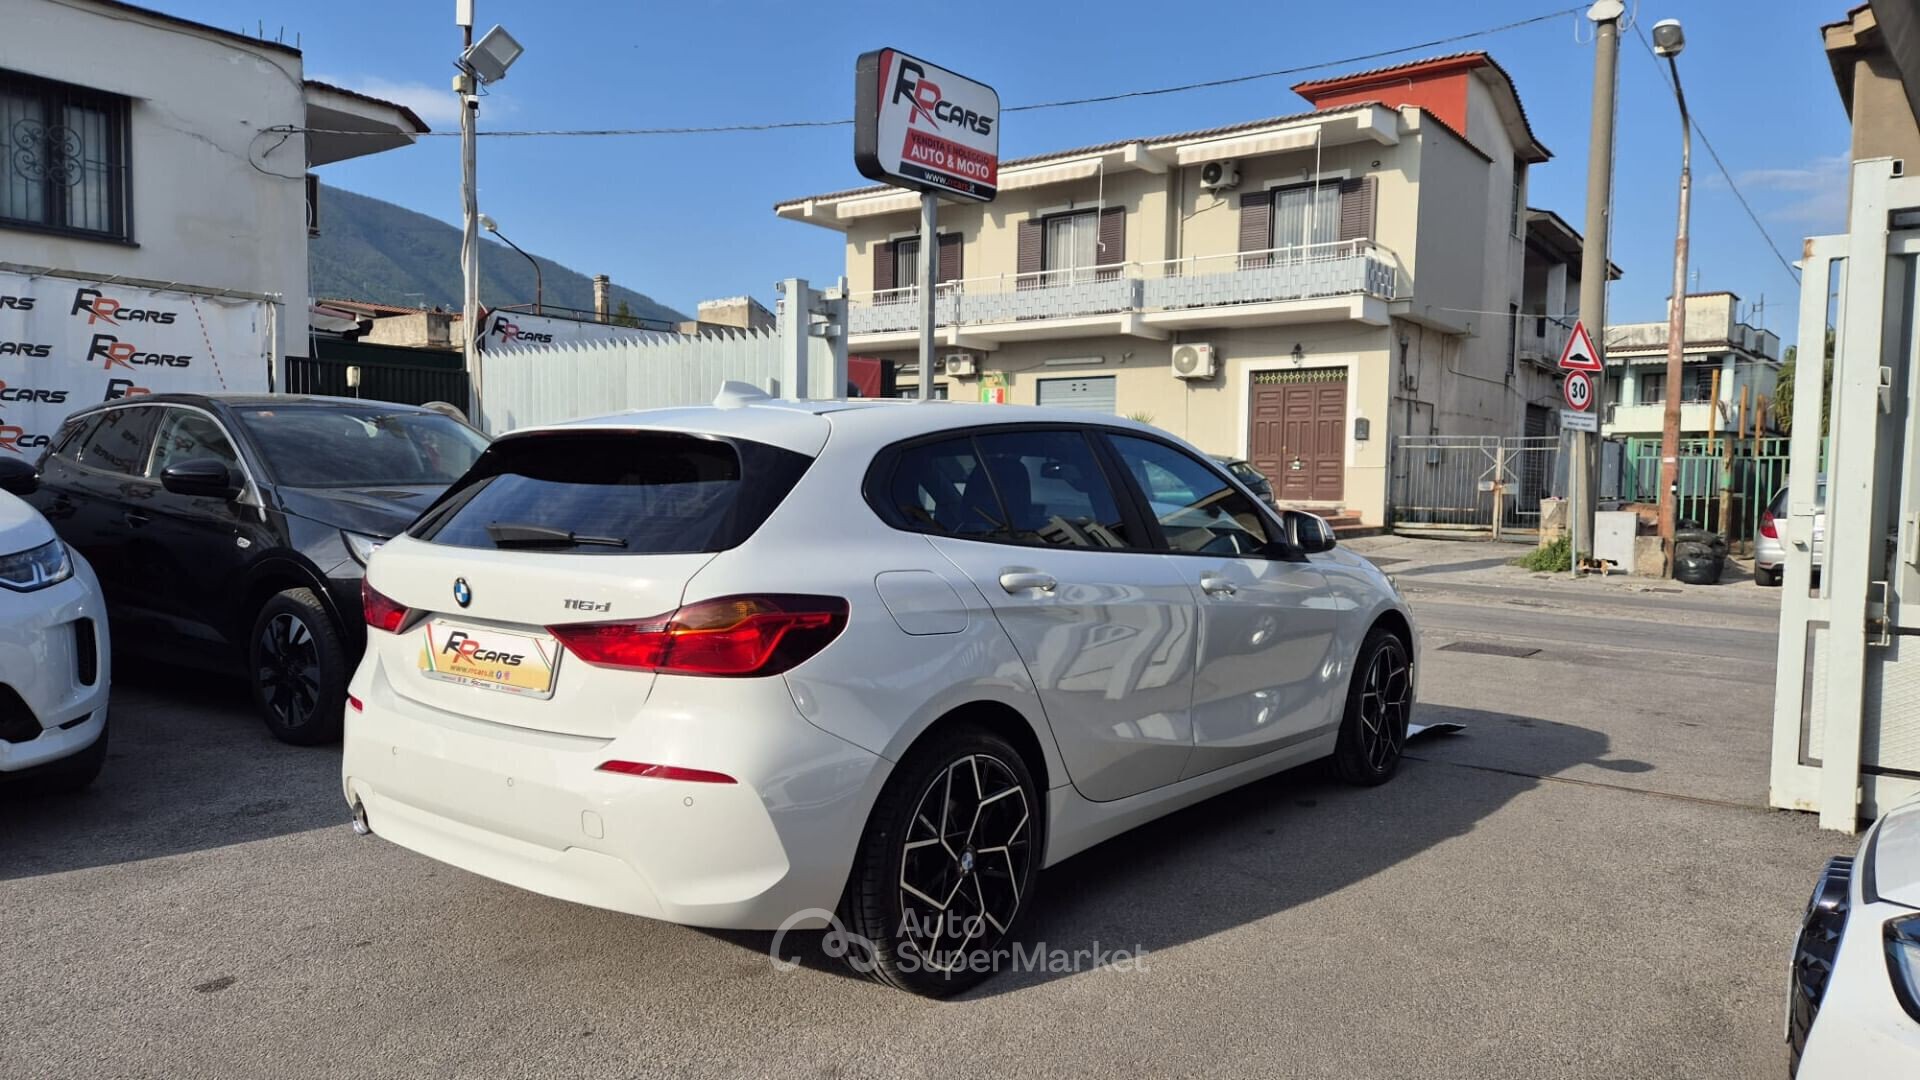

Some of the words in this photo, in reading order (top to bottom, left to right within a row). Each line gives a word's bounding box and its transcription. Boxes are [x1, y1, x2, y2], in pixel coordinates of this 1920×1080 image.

[911, 132, 945, 151] VENDITA
[911, 143, 944, 165] AUTO
[947, 155, 954, 169] &
[957, 157, 989, 178] MOTO
[0, 342, 53, 357] ARS
[1571, 382, 1586, 399] 30
[564, 599, 611, 612] 116d
